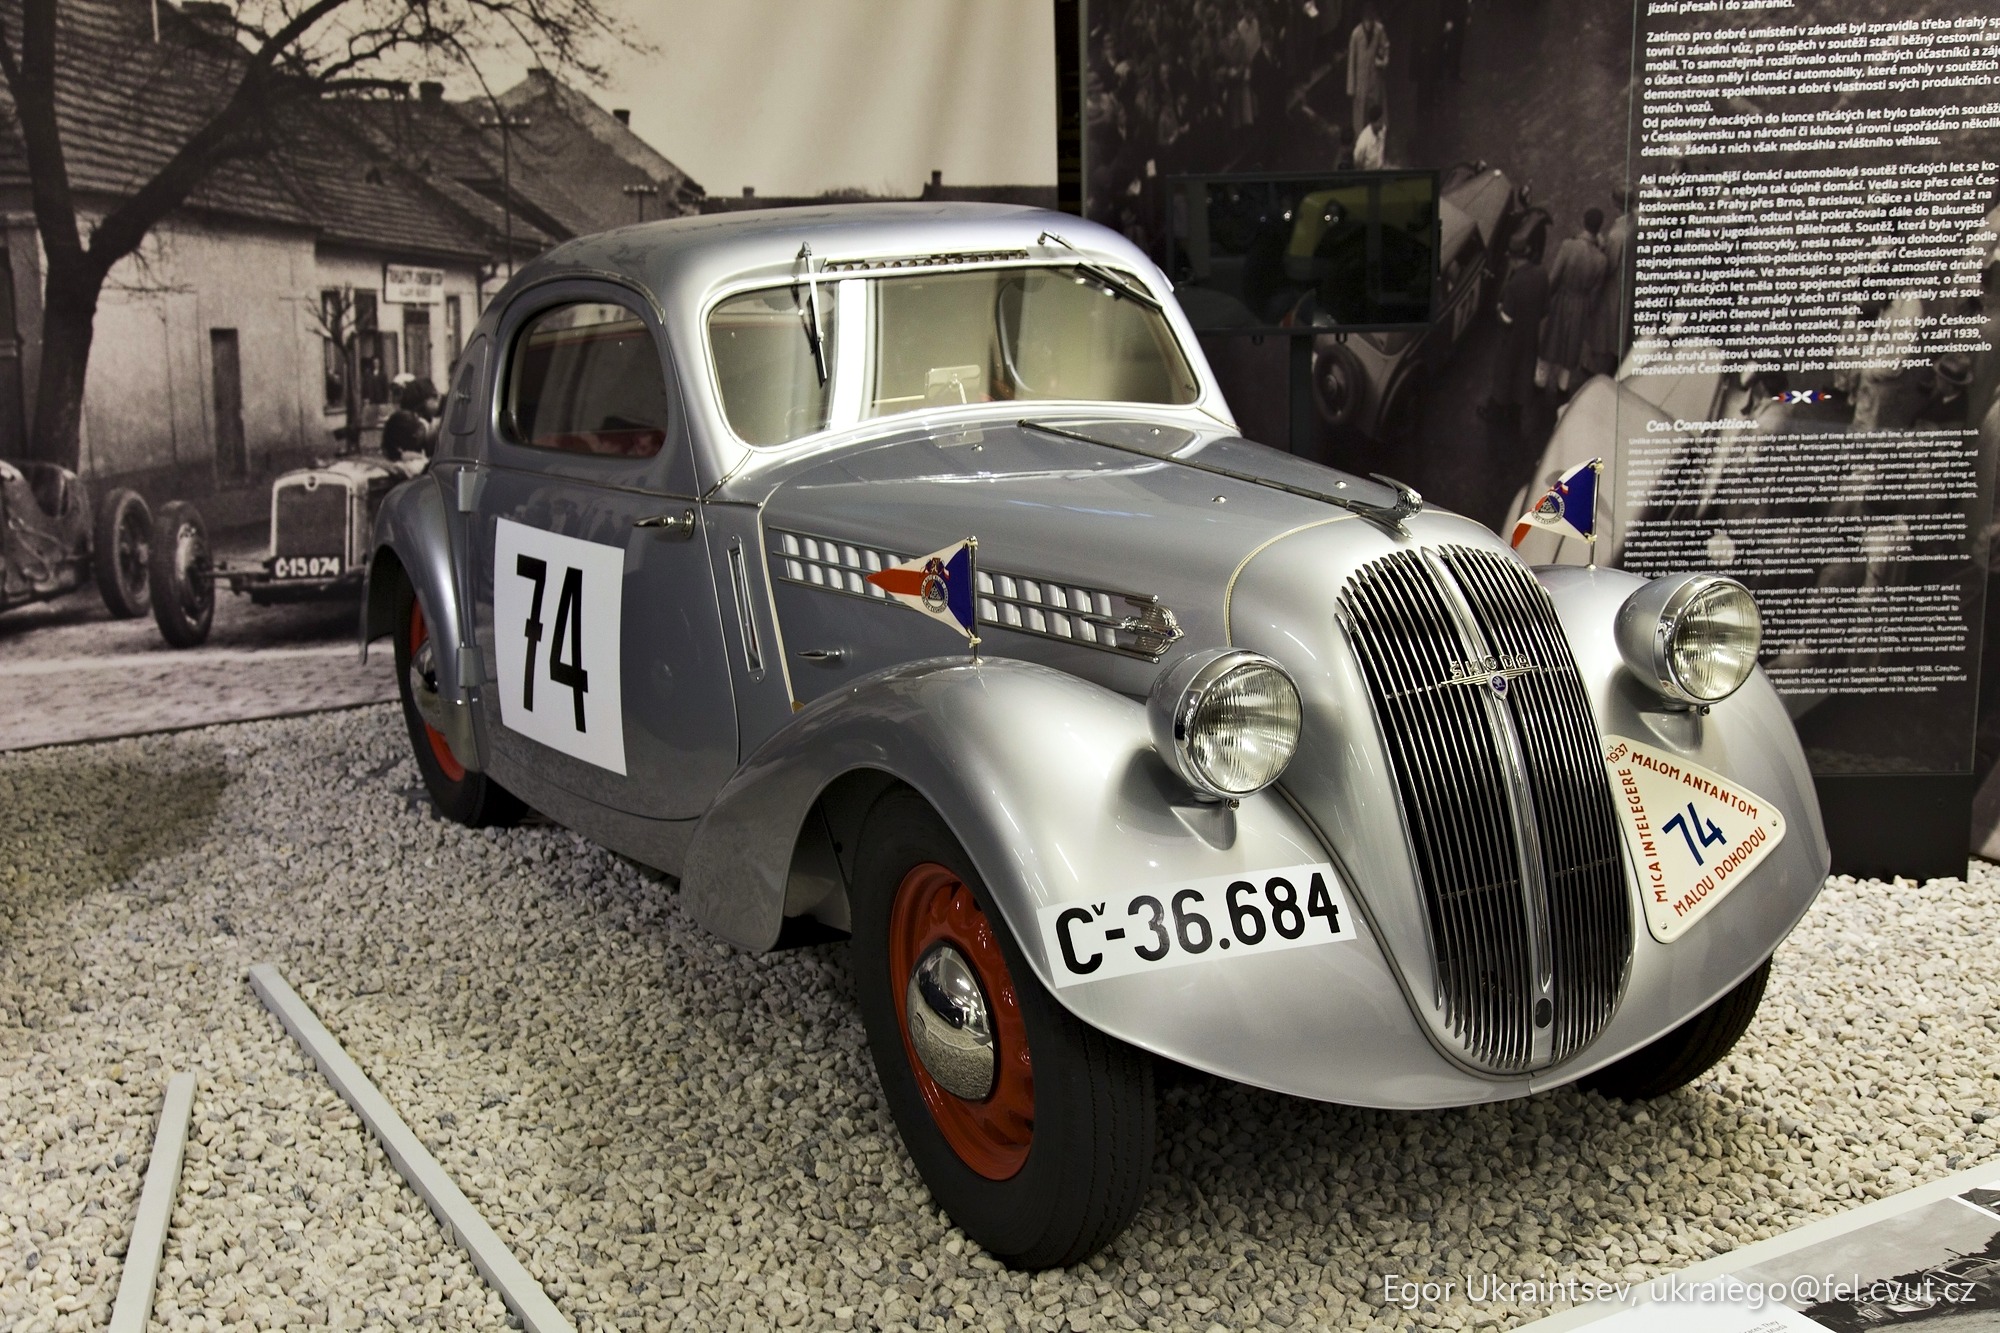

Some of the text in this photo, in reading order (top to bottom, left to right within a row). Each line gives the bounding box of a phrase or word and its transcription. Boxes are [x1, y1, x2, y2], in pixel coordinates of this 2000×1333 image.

[1646, 15, 1987, 43] Zatímco pro dobré umístění v závodě byl zpravidla třeba drahý
[1645, 45, 1980, 71] mobil. To samozřejmě rozšiřovalo okruh možných účastníků a
[1644, 59, 1998, 85] o účast často měly i domácí automobilky, které mohly v soutěžích
[1643, 73, 1991, 100] demonstrovat spolehlivost a dobré vlastnosti svých produkčních
[1642, 99, 1714, 114] tovních vozů.
[1640, 134, 1941, 156] desítek, žádná z nich však nedosáhla zvláštního věhlasu.
[1639, 160, 2000, 186] Asi nejvýznamnější domácí automobilová soutěž třicátých let se ko-
[1639, 172, 2000, 198] nala v září 1937 a nebyla tak úplně domácí. Vedla sice přes celé Čes-
[1638, 188, 1992, 212] koslovensko, z Prahy přes Brno, Bratislavu, Košice a Užhorod až na
[1638, 201, 1984, 226] hranice s Rumunskem, odtud však pokračovala dále do Bukurešti
[1635, 257, 1982, 281] Rumunska a Jugoslávie. Ve zhoršující se politické atmosféře druhé
[1636, 244, 1986, 270] stejnojmenného vojensko-politického spojenectví Československa,
[1646, 418, 1760, 433] Car Competitions
[517, 554, 588, 733] 74
[1450, 653, 1530, 680] ŠKODA
[1606, 743, 1630, 764] 1937
[1631, 752, 1758, 819] MALOM ANTANTOM
[1618, 768, 1668, 903] MICA INTELEGERE
[1662, 802, 1728, 866] 74
[1673, 826, 1766, 917] MALOU DOHODOU
